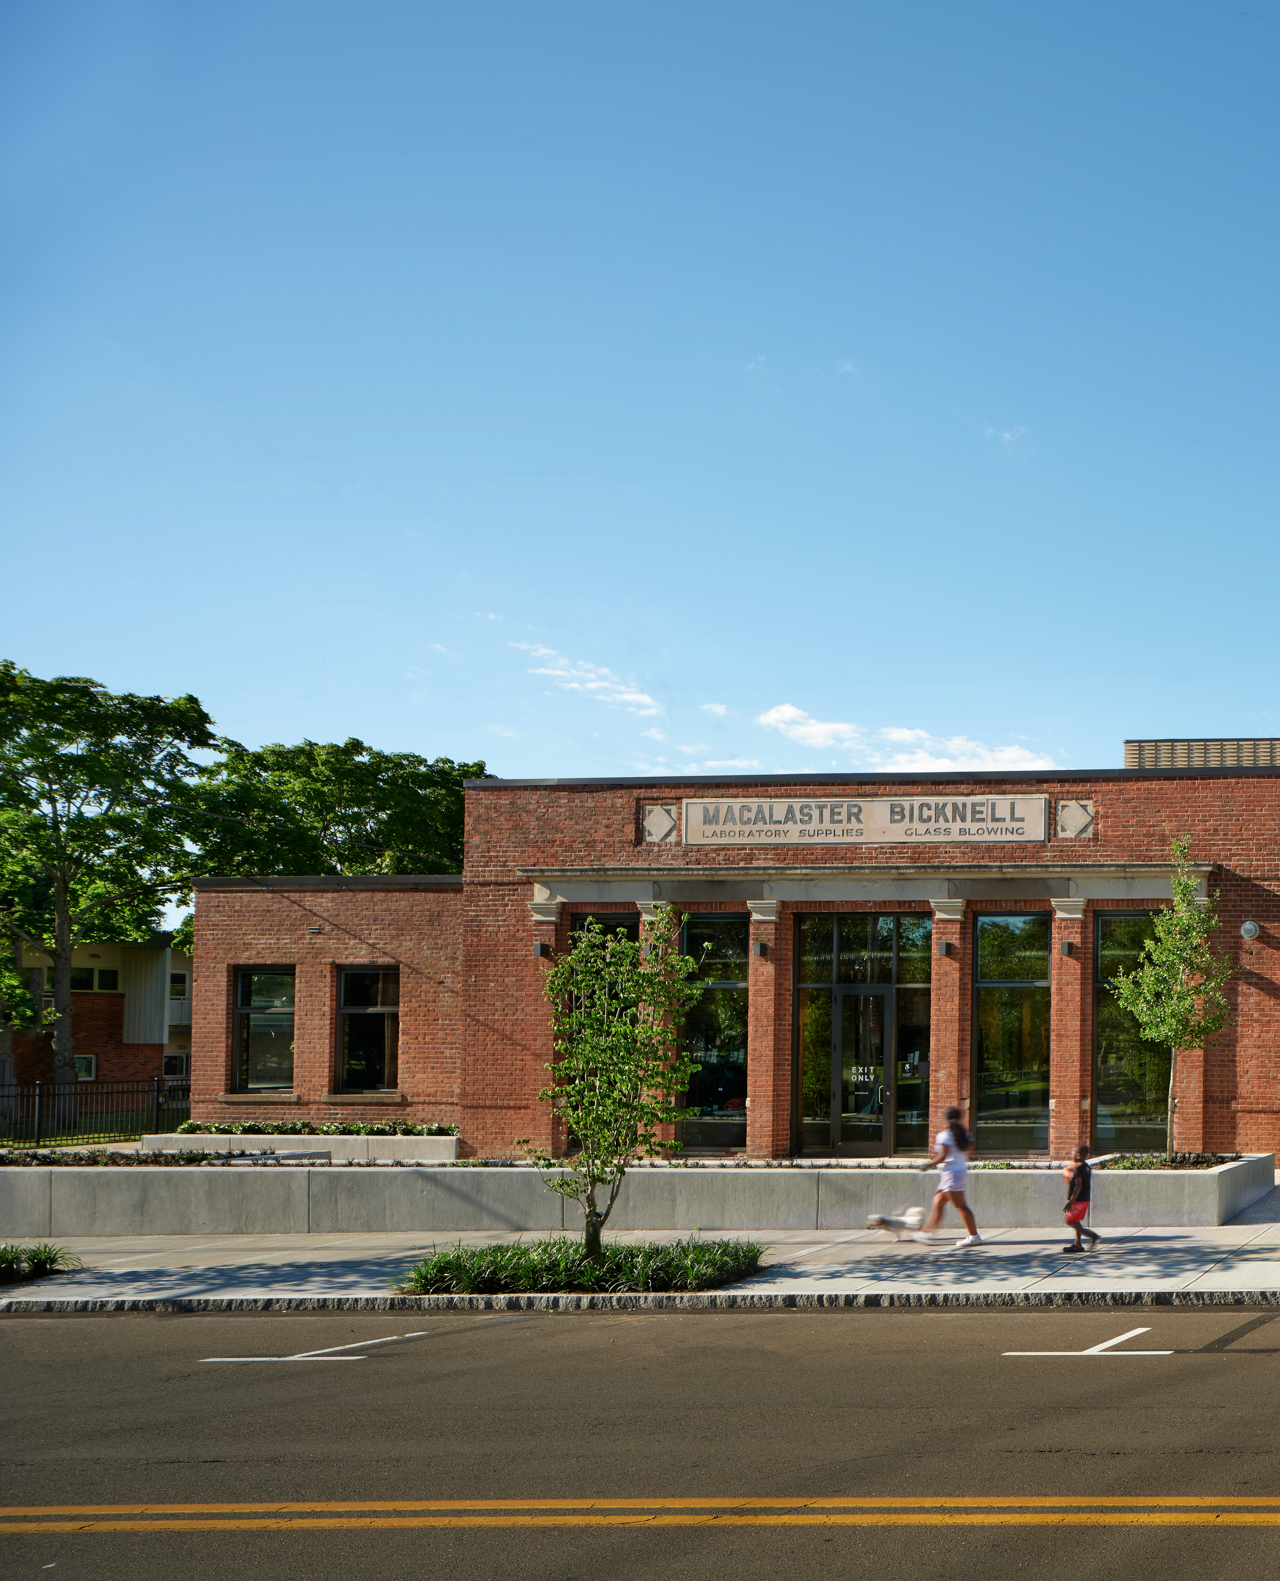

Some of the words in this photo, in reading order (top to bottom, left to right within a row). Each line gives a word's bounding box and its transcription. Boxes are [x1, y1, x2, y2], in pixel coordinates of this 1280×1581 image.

[702, 803, 864, 826] MACALASTER
[889, 801, 1026, 824] BICKNELL
[702, 829, 790, 839] LABORATORY
[798, 828, 864, 839] SUPPLIES
[904, 827, 951, 837] GLASS
[958, 826, 1026, 837] BLOWING
